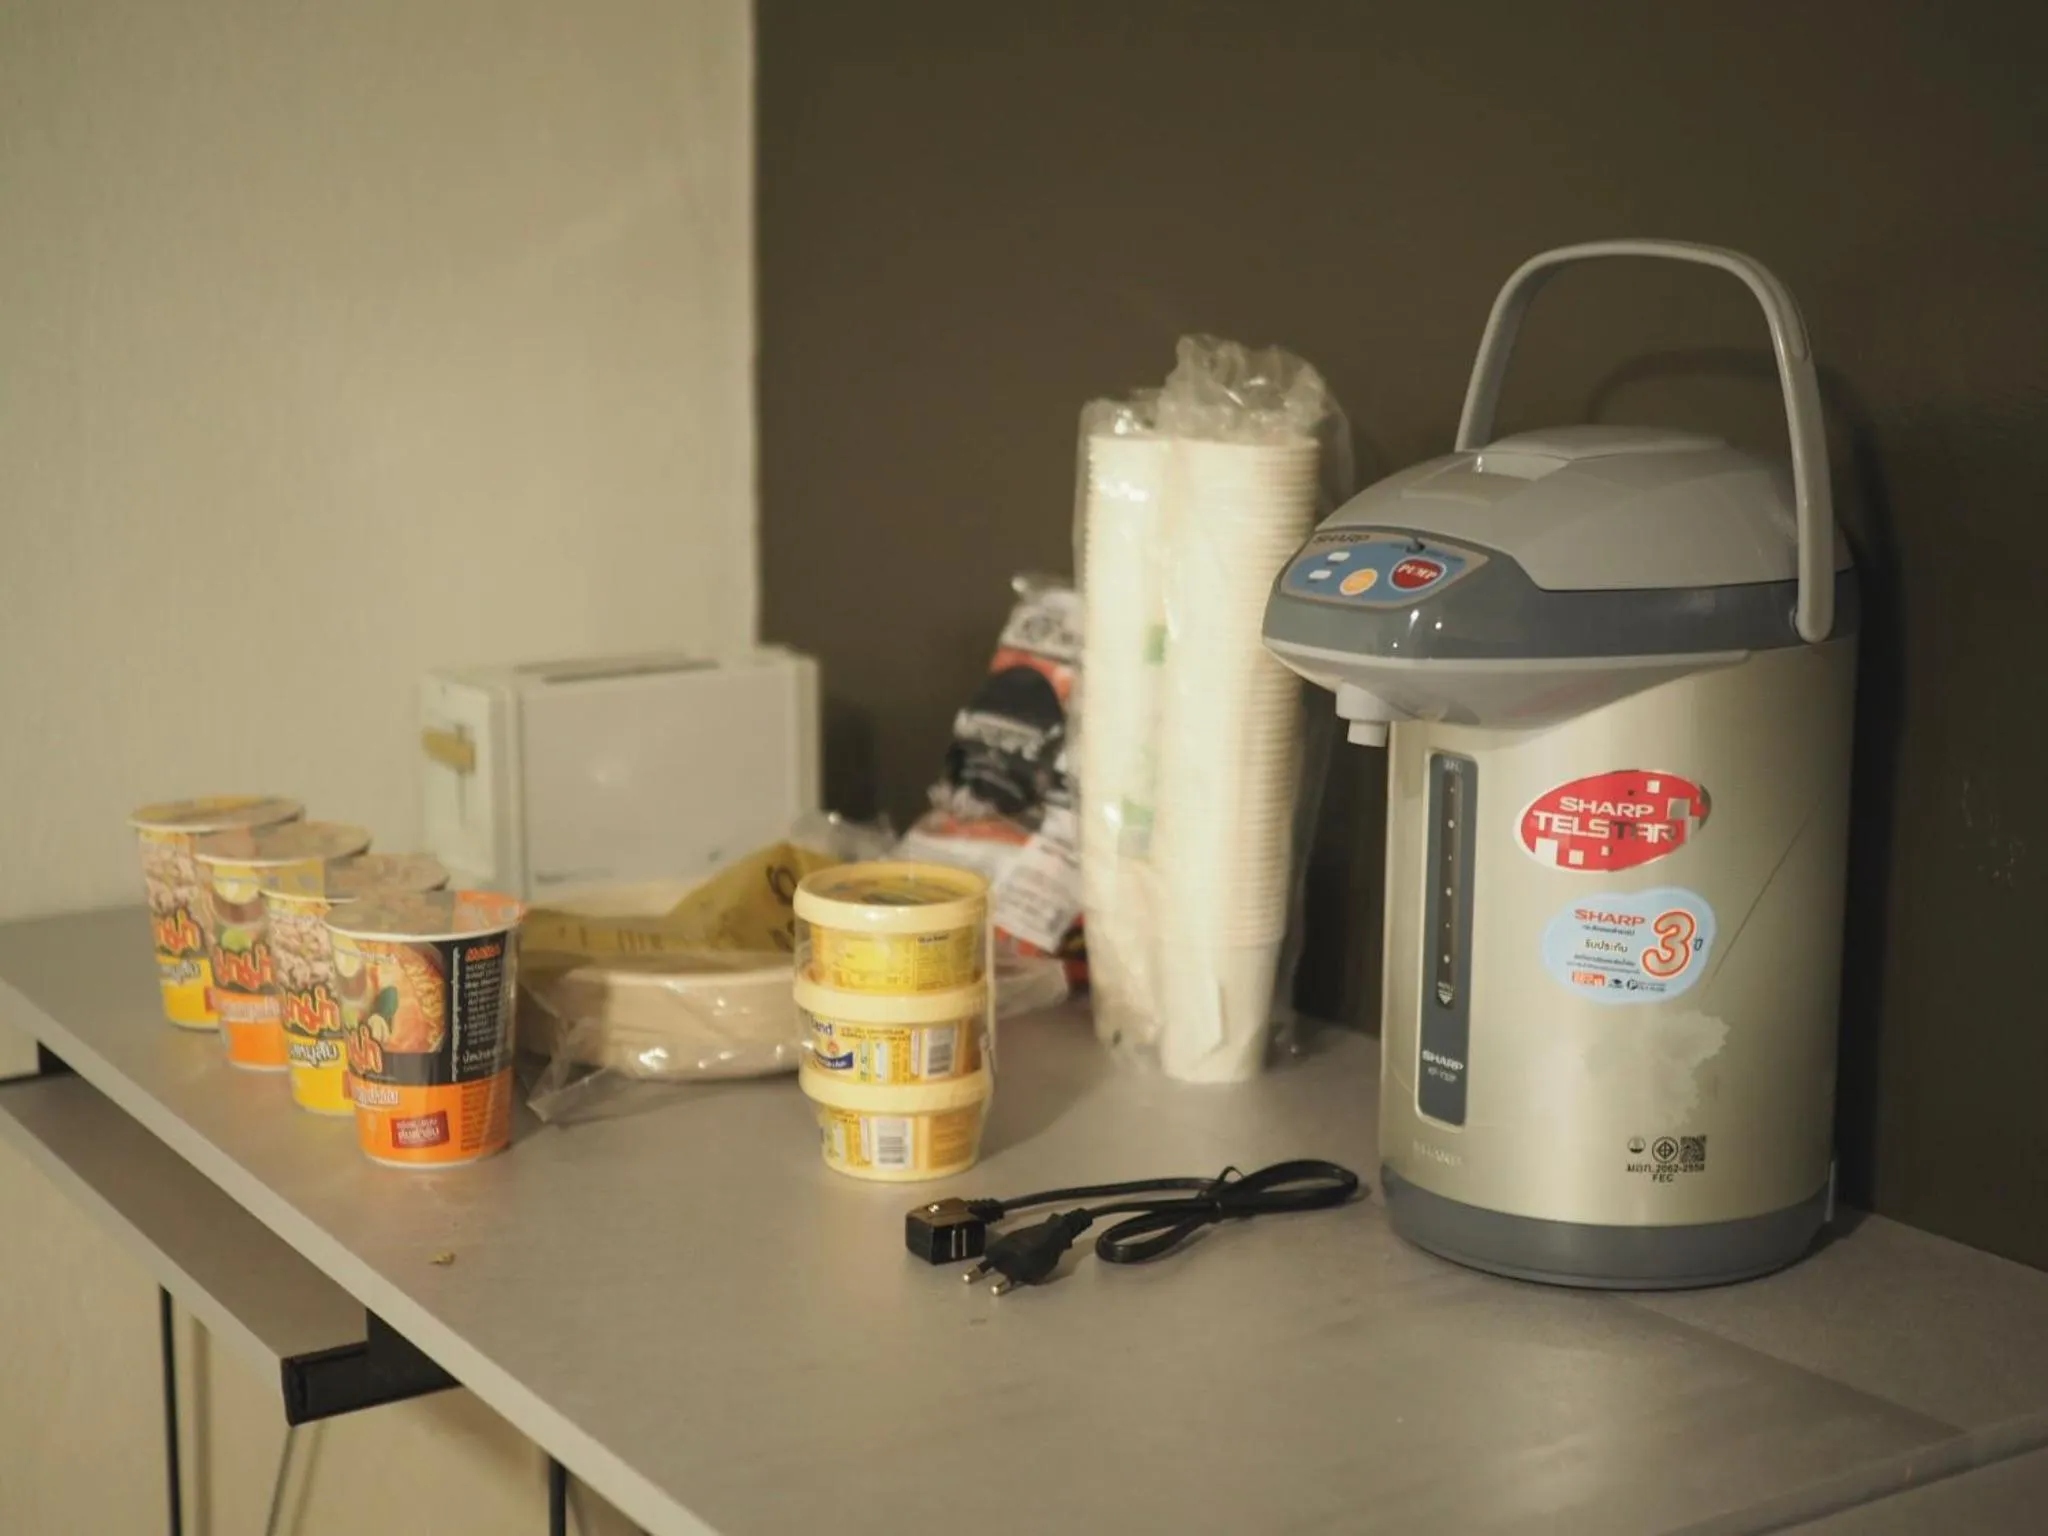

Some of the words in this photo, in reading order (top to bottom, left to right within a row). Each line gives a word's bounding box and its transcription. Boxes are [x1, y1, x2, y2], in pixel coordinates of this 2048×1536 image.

[1397, 563, 1439, 580] PUMP
[1559, 796, 1655, 818] SHARP
[1532, 809, 1676, 844] TELSTAR
[1574, 908, 1646, 927] SHARP
[1640, 909, 1697, 979] 3
[1421, 1049, 1465, 1071] SHARP
[1651, 1173, 1675, 1184] FEC
